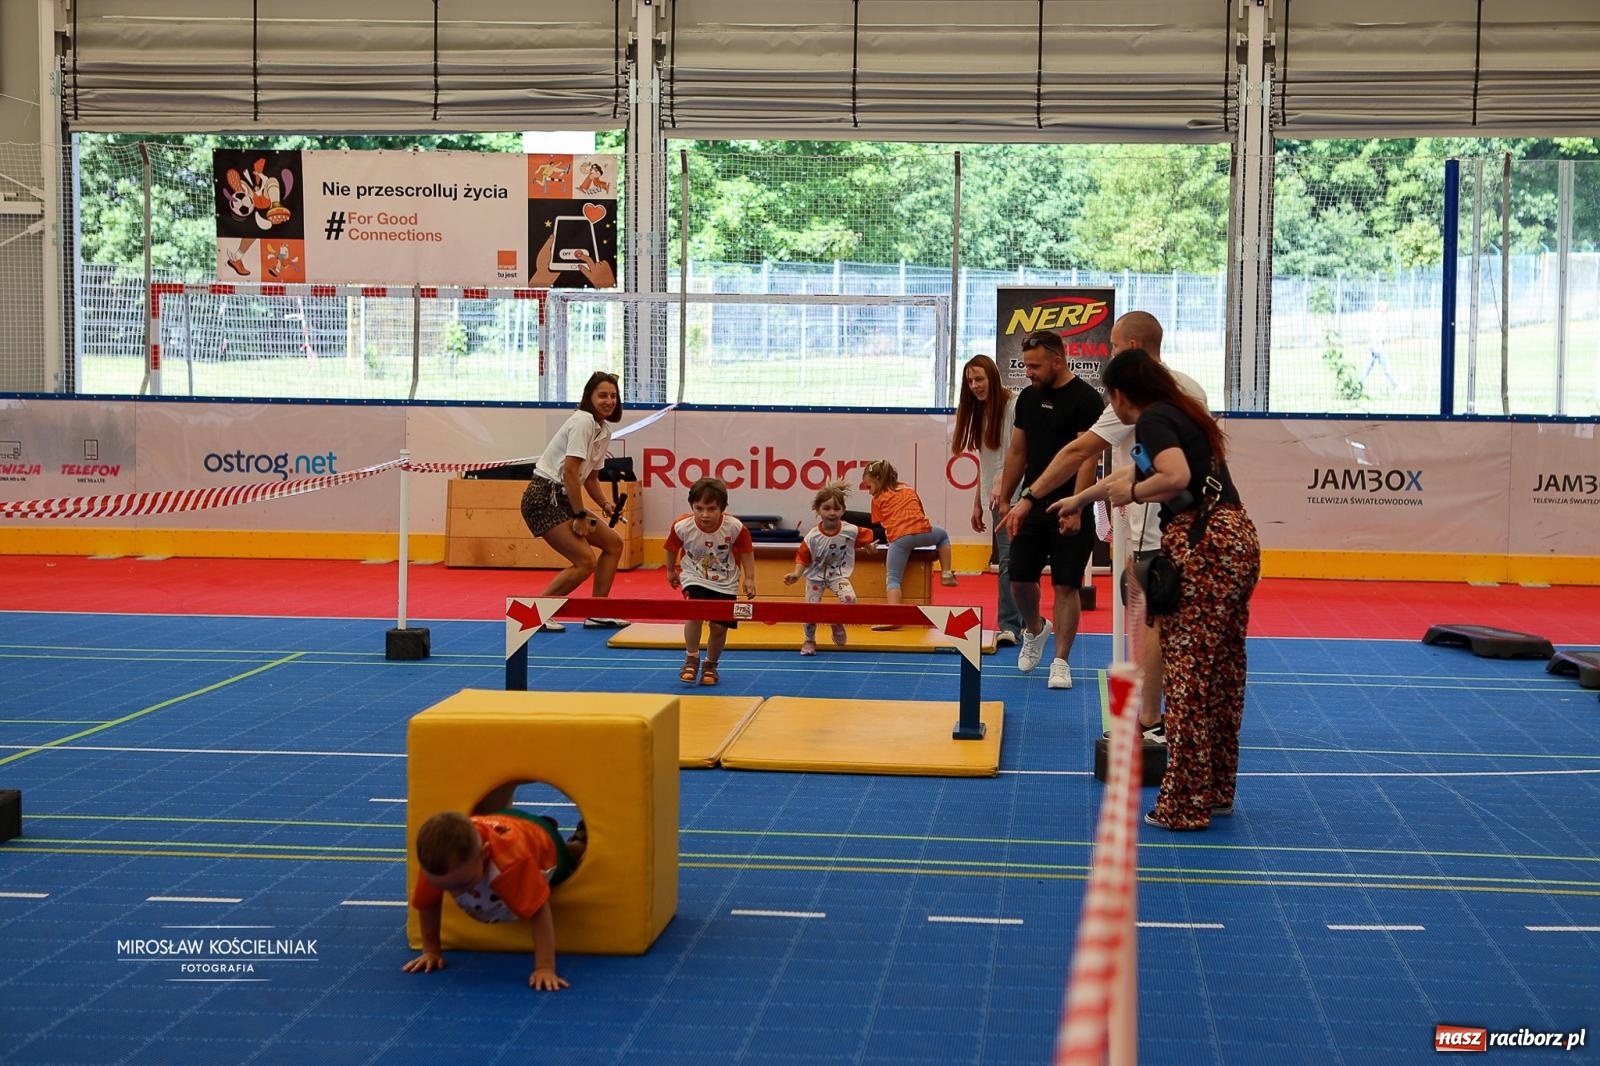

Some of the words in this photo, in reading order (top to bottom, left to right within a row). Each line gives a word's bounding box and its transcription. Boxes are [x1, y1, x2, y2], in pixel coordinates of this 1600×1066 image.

[322, 181, 351, 196] Nie
[356, 183, 458, 200] przescrolluj
[463, 183, 508, 201] życia
[324, 211, 346, 241] #
[348, 211, 373, 225] For
[377, 211, 418, 226] Good
[348, 228, 443, 242] Connections
[1005, 301, 1107, 335] NERF
[0, 464, 42, 476] WIZJA
[61, 464, 121, 477] TELEFON
[203, 450, 338, 481] ostrog.net
[1307, 497, 1349, 505] TELEWIZJA
[1350, 496, 1424, 506] ŚWIATŁOWODOWA
